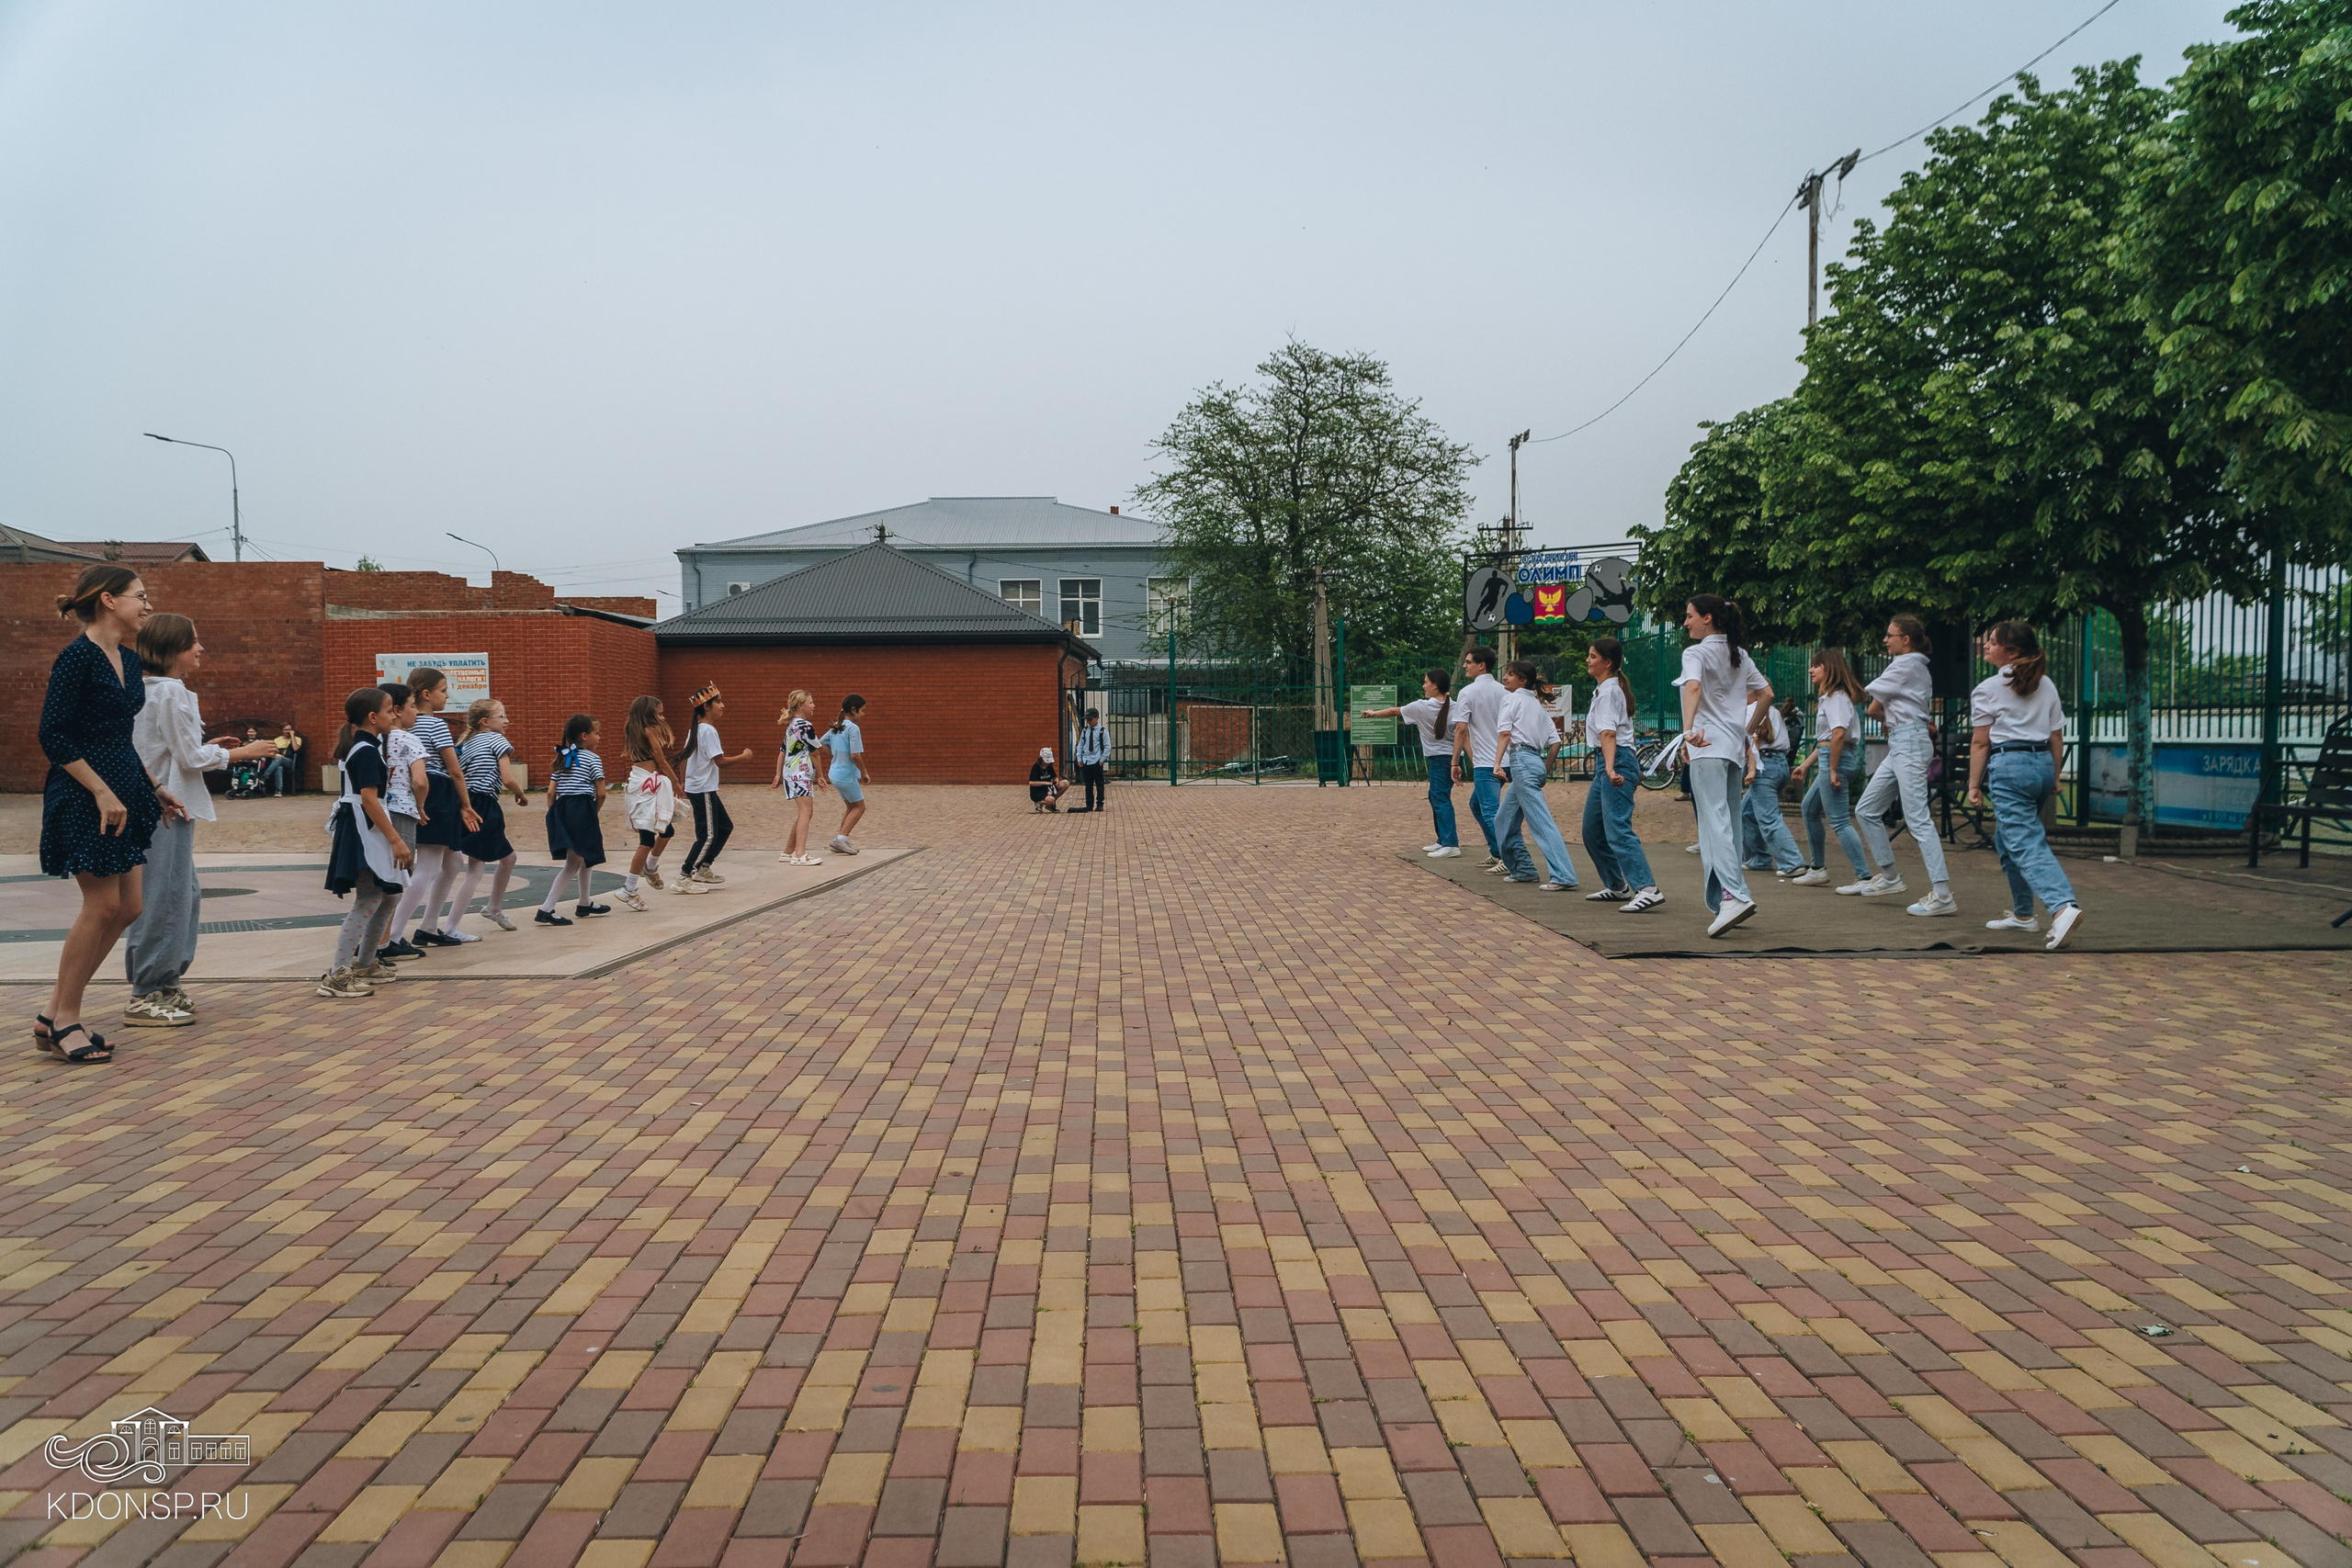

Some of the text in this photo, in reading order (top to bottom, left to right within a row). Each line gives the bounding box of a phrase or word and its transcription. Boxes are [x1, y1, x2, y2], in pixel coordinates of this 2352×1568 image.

[1521, 552, 1578, 565] СТАДИОН
[1518, 564, 1582, 583] ОЛИМП
[2202, 755, 2261, 774] ЗАРЯДКА
